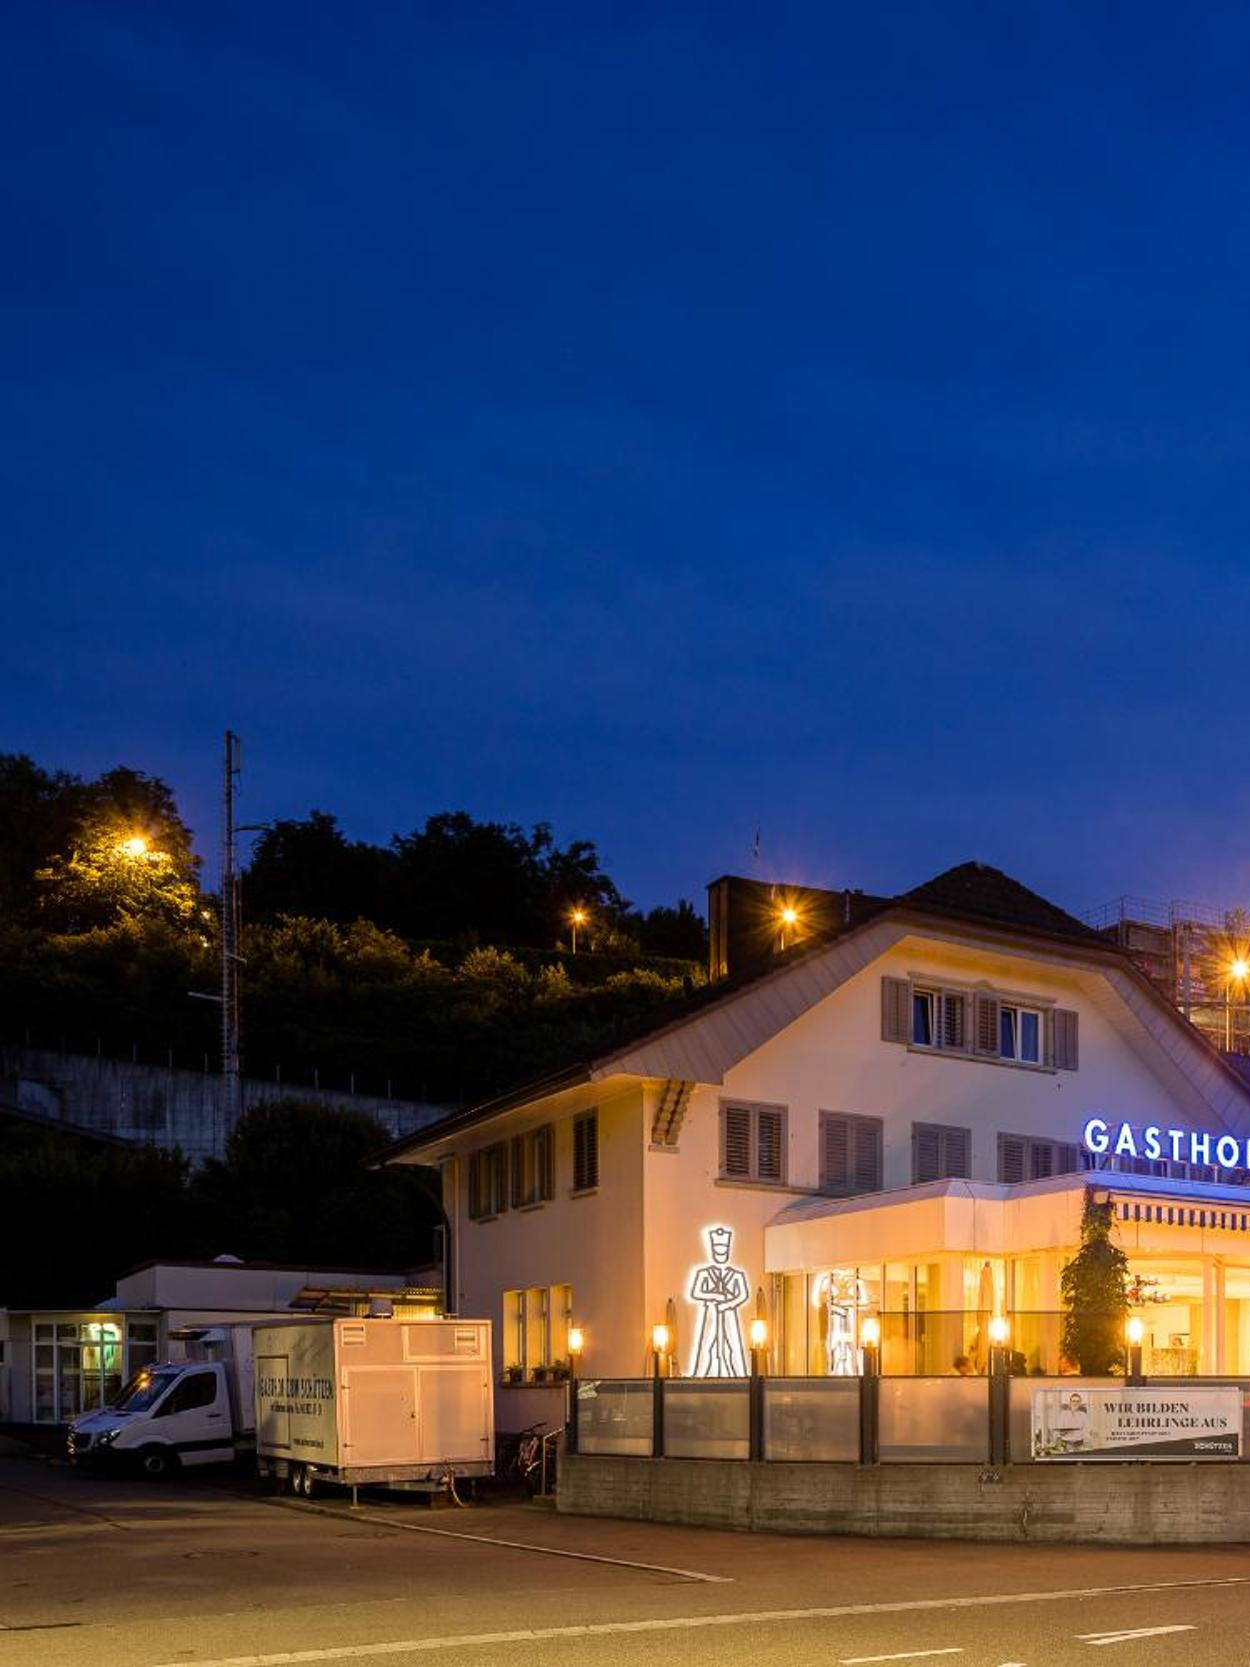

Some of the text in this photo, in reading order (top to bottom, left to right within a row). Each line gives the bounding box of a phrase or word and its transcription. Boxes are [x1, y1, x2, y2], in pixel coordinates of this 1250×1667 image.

[1104, 1403, 1189, 1413] WIR BILDEN
[1118, 1417, 1228, 1428] LEHRLINGE AUS
